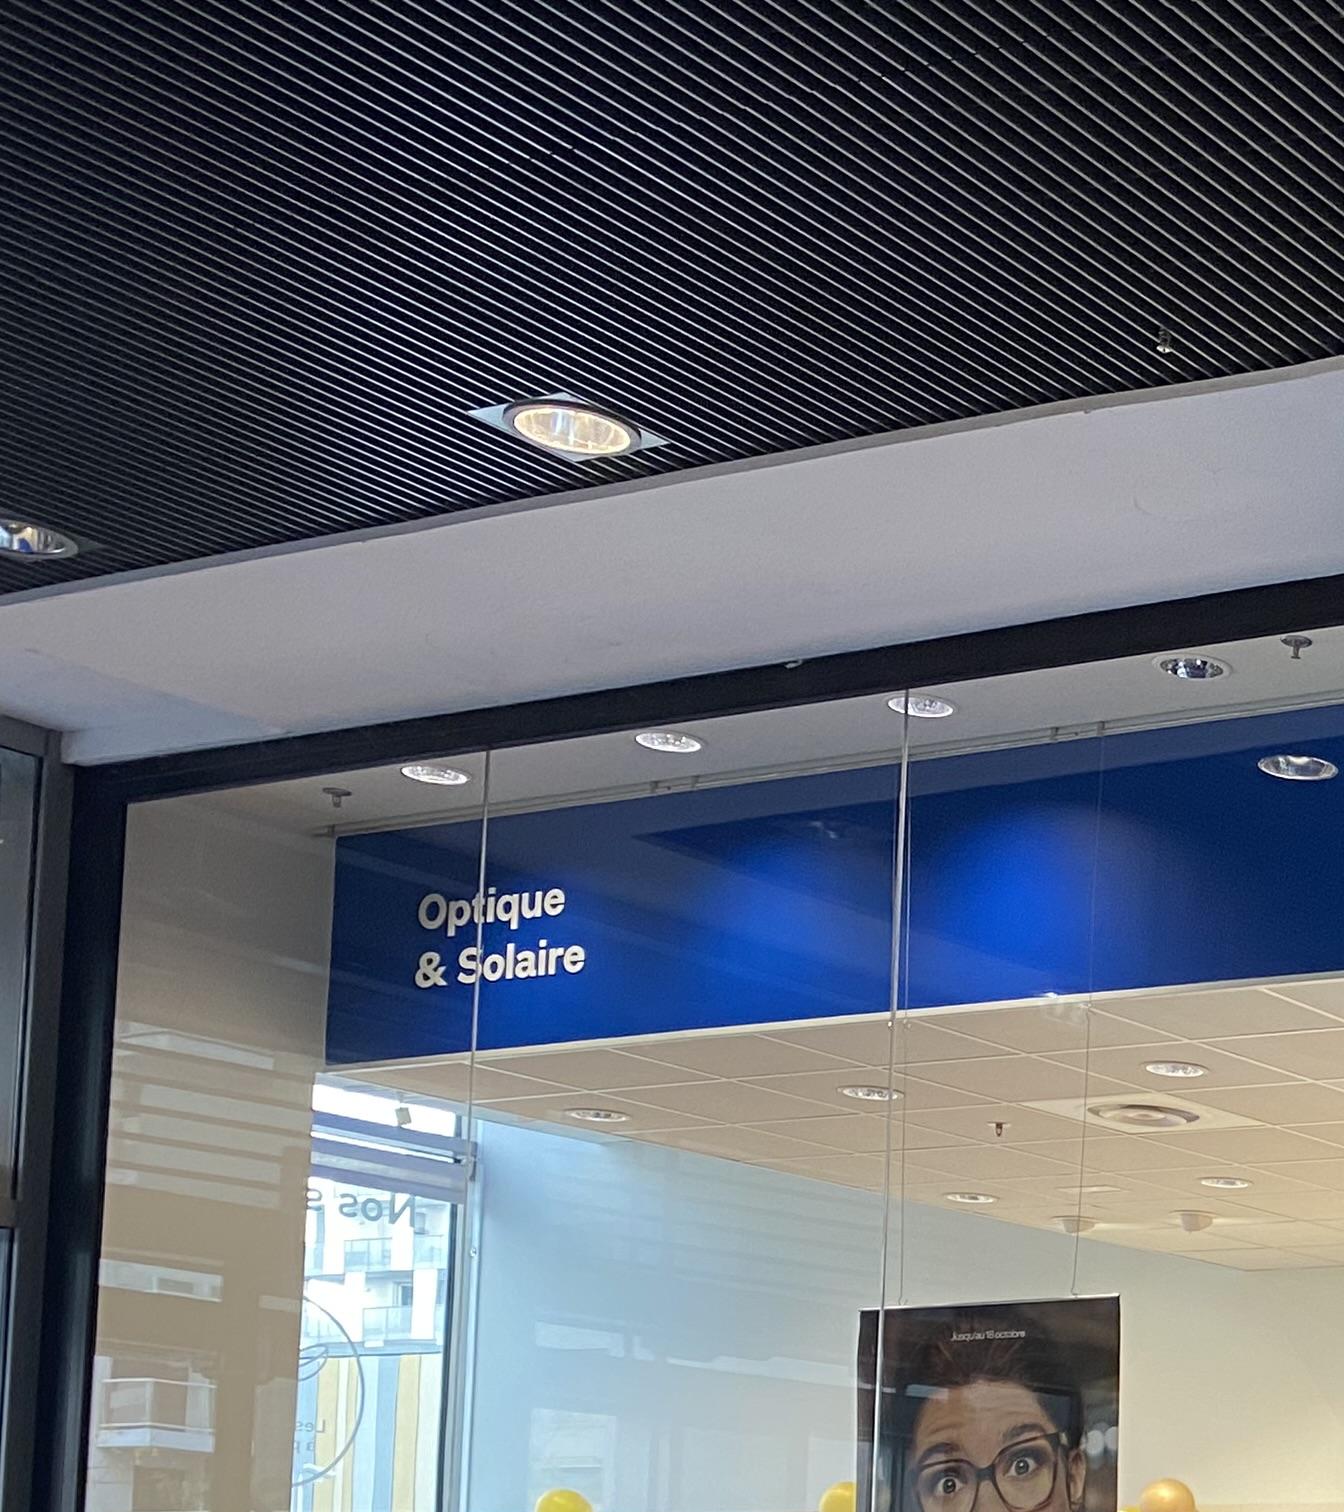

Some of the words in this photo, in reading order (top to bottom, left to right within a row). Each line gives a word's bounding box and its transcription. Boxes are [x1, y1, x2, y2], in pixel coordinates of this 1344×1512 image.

[417, 887, 566, 937] Optique
[414, 951, 448, 988] &
[457, 939, 586, 984] Solaire
